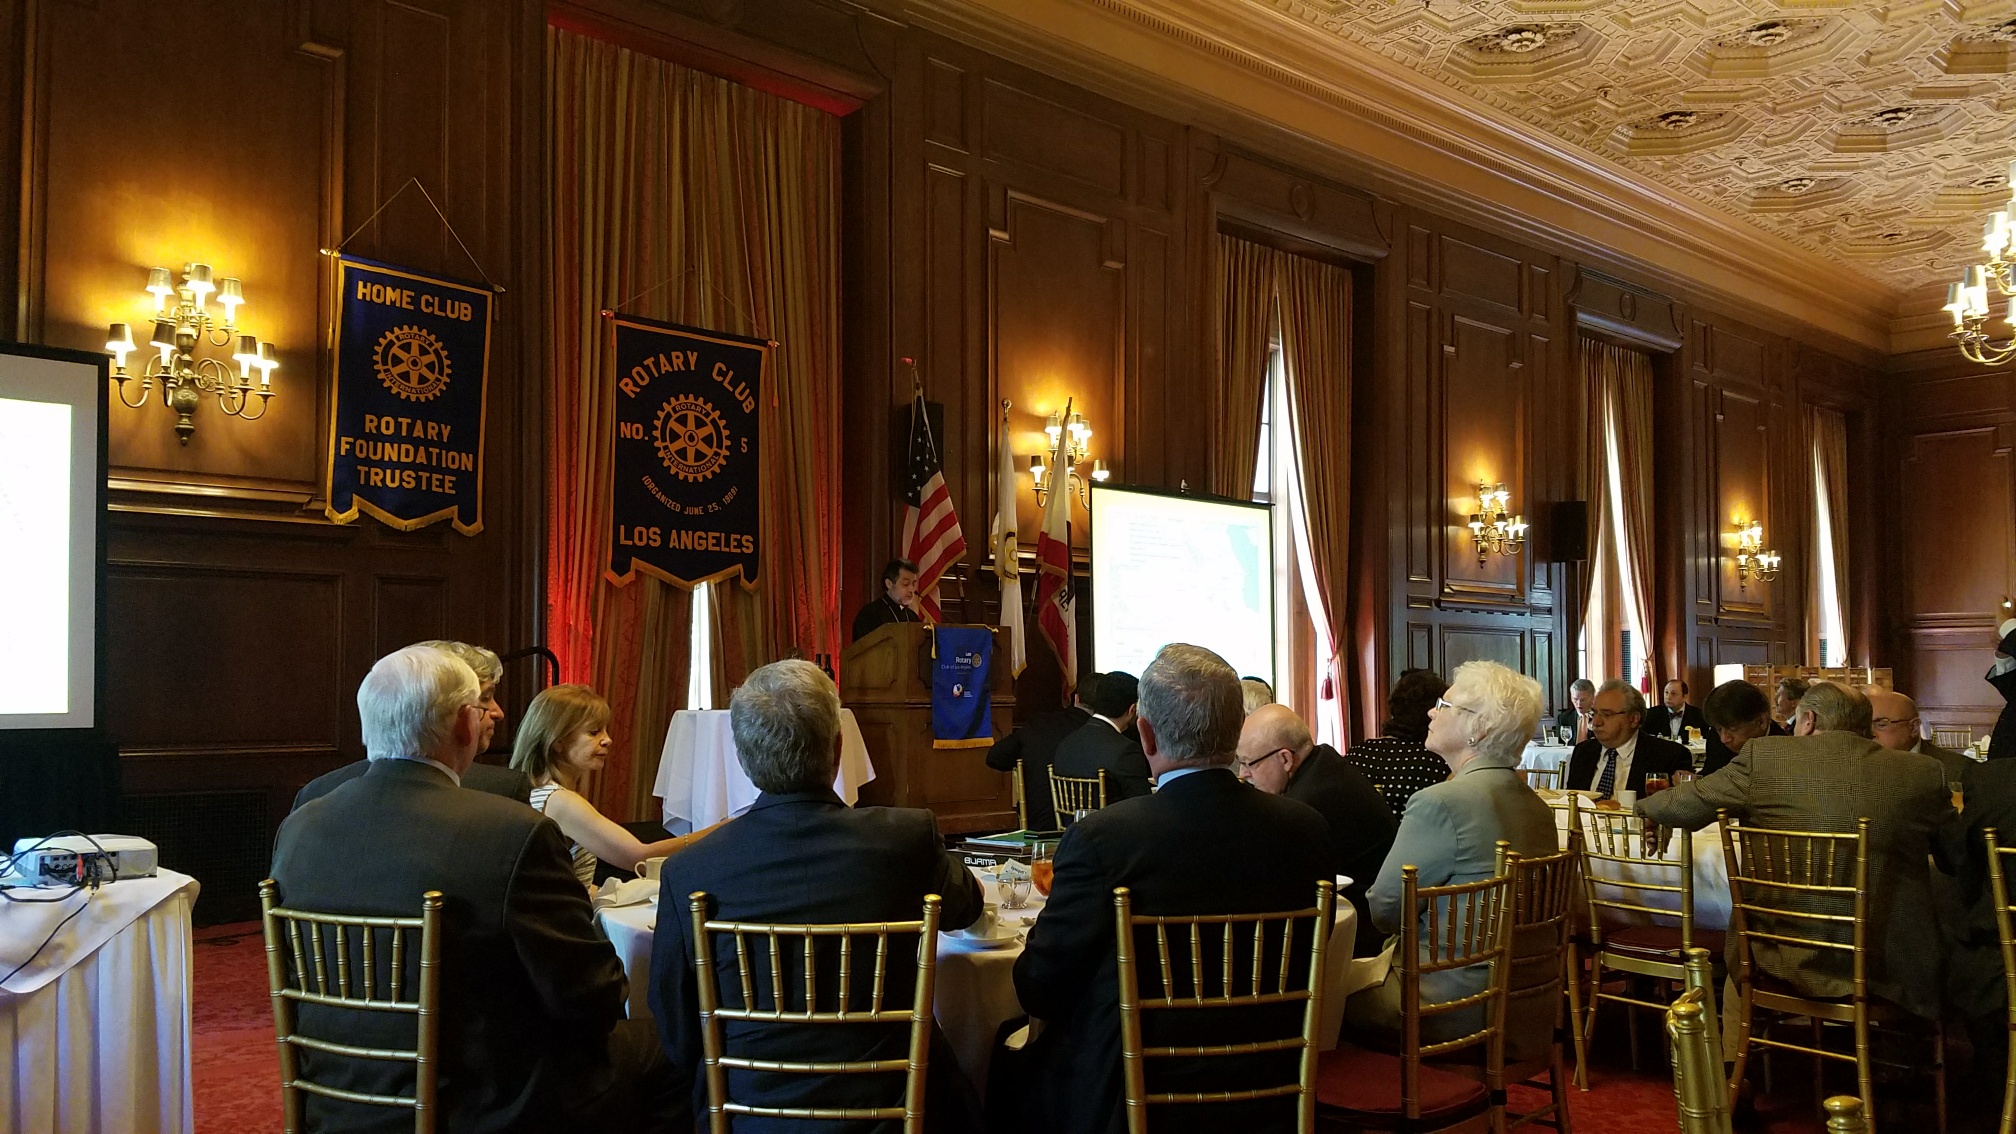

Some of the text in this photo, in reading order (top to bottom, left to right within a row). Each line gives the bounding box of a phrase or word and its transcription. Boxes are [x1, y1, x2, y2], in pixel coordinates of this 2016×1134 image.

[356, 280, 473, 321] HOME CLUB
[398, 332, 431, 346] ROTARY
[385, 370, 441, 395] INTERNATIONAL
[618, 351, 756, 415] ROTARY CLUB
[674, 402, 708, 416] ROTARY
[364, 414, 452, 443] ROTARY
[620, 421, 748, 453] NO. 5
[340, 436, 474, 472] FOUNDATION
[664, 448, 720, 474] INTERNATIONAL
[356, 465, 457, 495] TRUSTEE
[641, 475, 738, 515] (ORGANIZED JUNE 25, 1909)
[619, 525, 754, 554] LOS ANGELES
[955, 656, 972, 664] Rotary
[964, 856, 997, 867] BURMA
